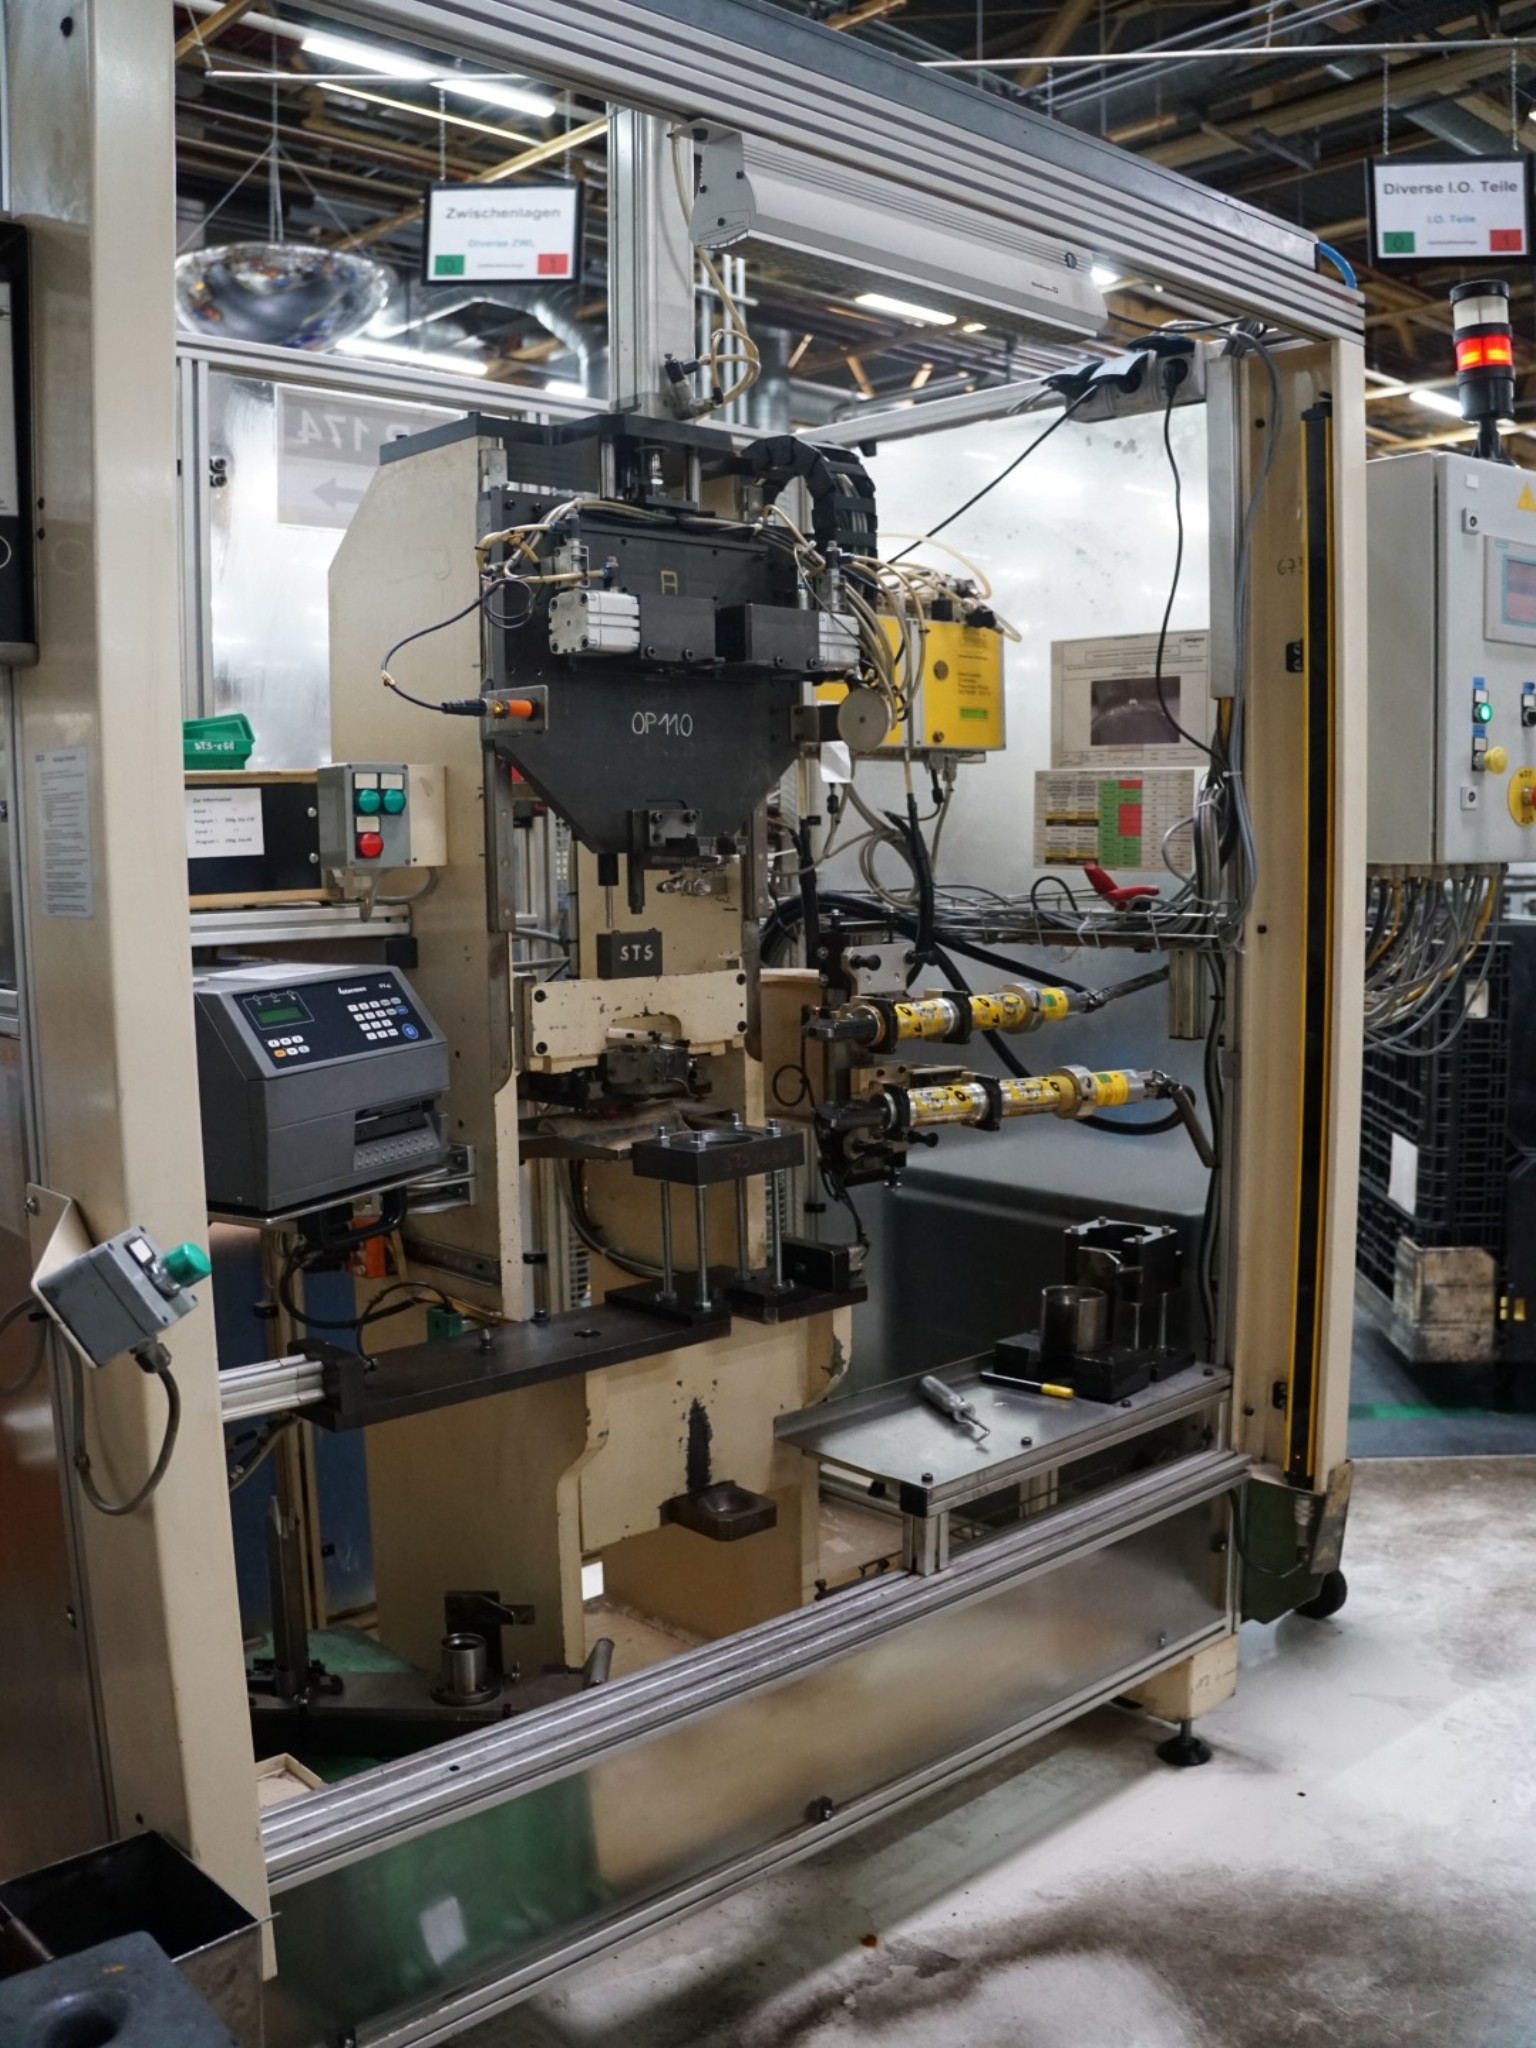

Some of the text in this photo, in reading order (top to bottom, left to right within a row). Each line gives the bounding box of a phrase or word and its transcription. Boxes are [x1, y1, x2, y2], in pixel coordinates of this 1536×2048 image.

[1383, 180, 1519, 195] Diverse I.O. Teile
[446, 208, 561, 221] Zwischenlagen
